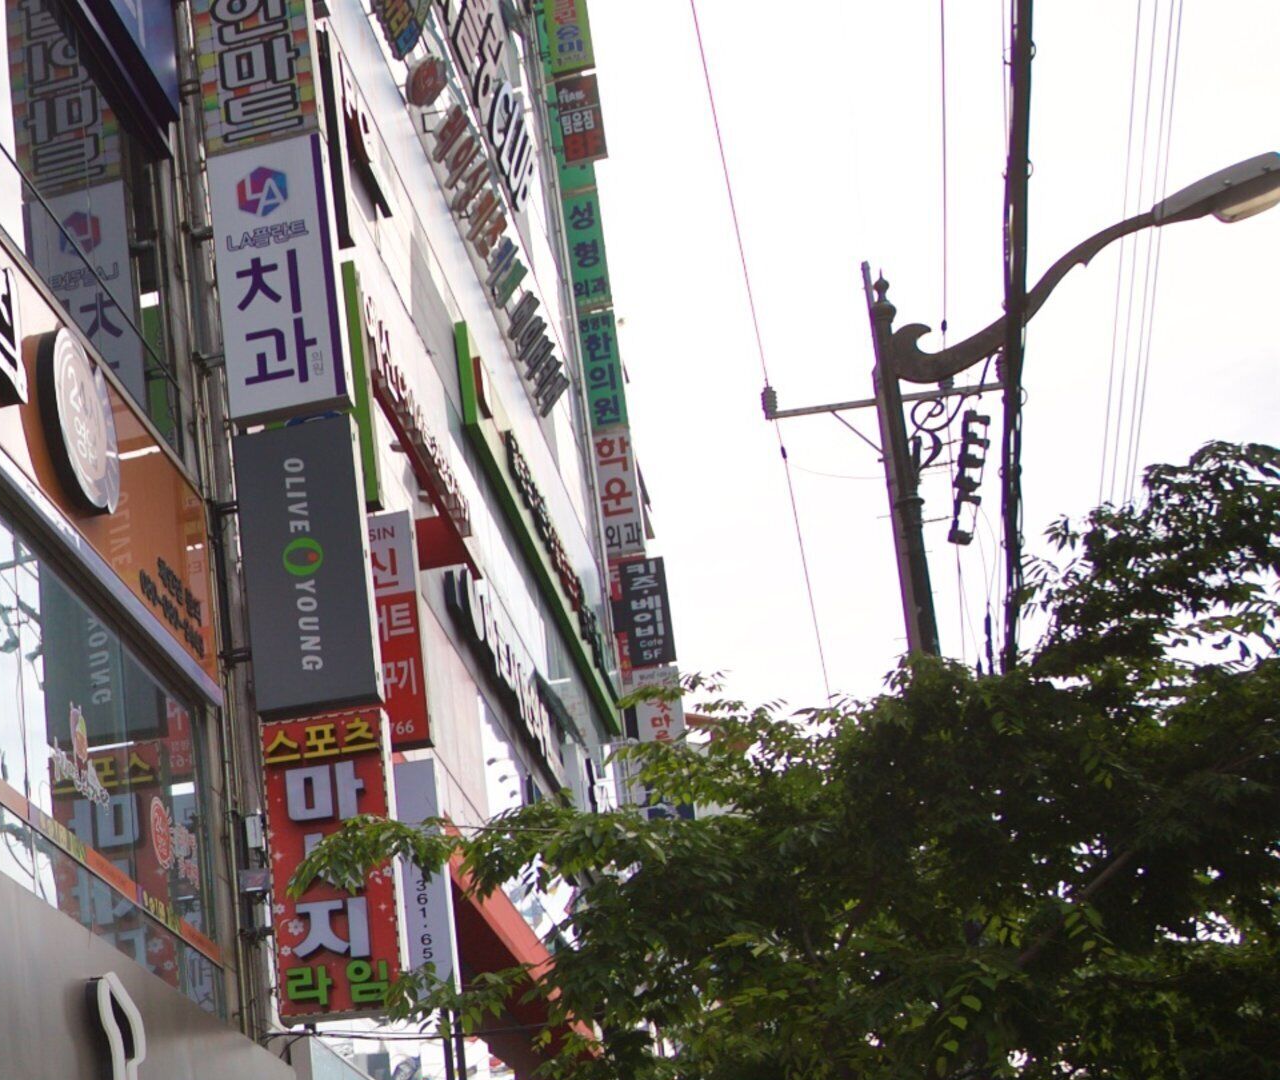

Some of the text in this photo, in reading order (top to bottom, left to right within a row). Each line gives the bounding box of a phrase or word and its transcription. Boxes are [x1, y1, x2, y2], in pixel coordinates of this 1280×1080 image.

[235, 248, 317, 388] 치과
[282, 457, 323, 673] OLIVE YOUNG
[265, 716, 381, 765] 스포츠
[285, 962, 390, 1005] 라임
